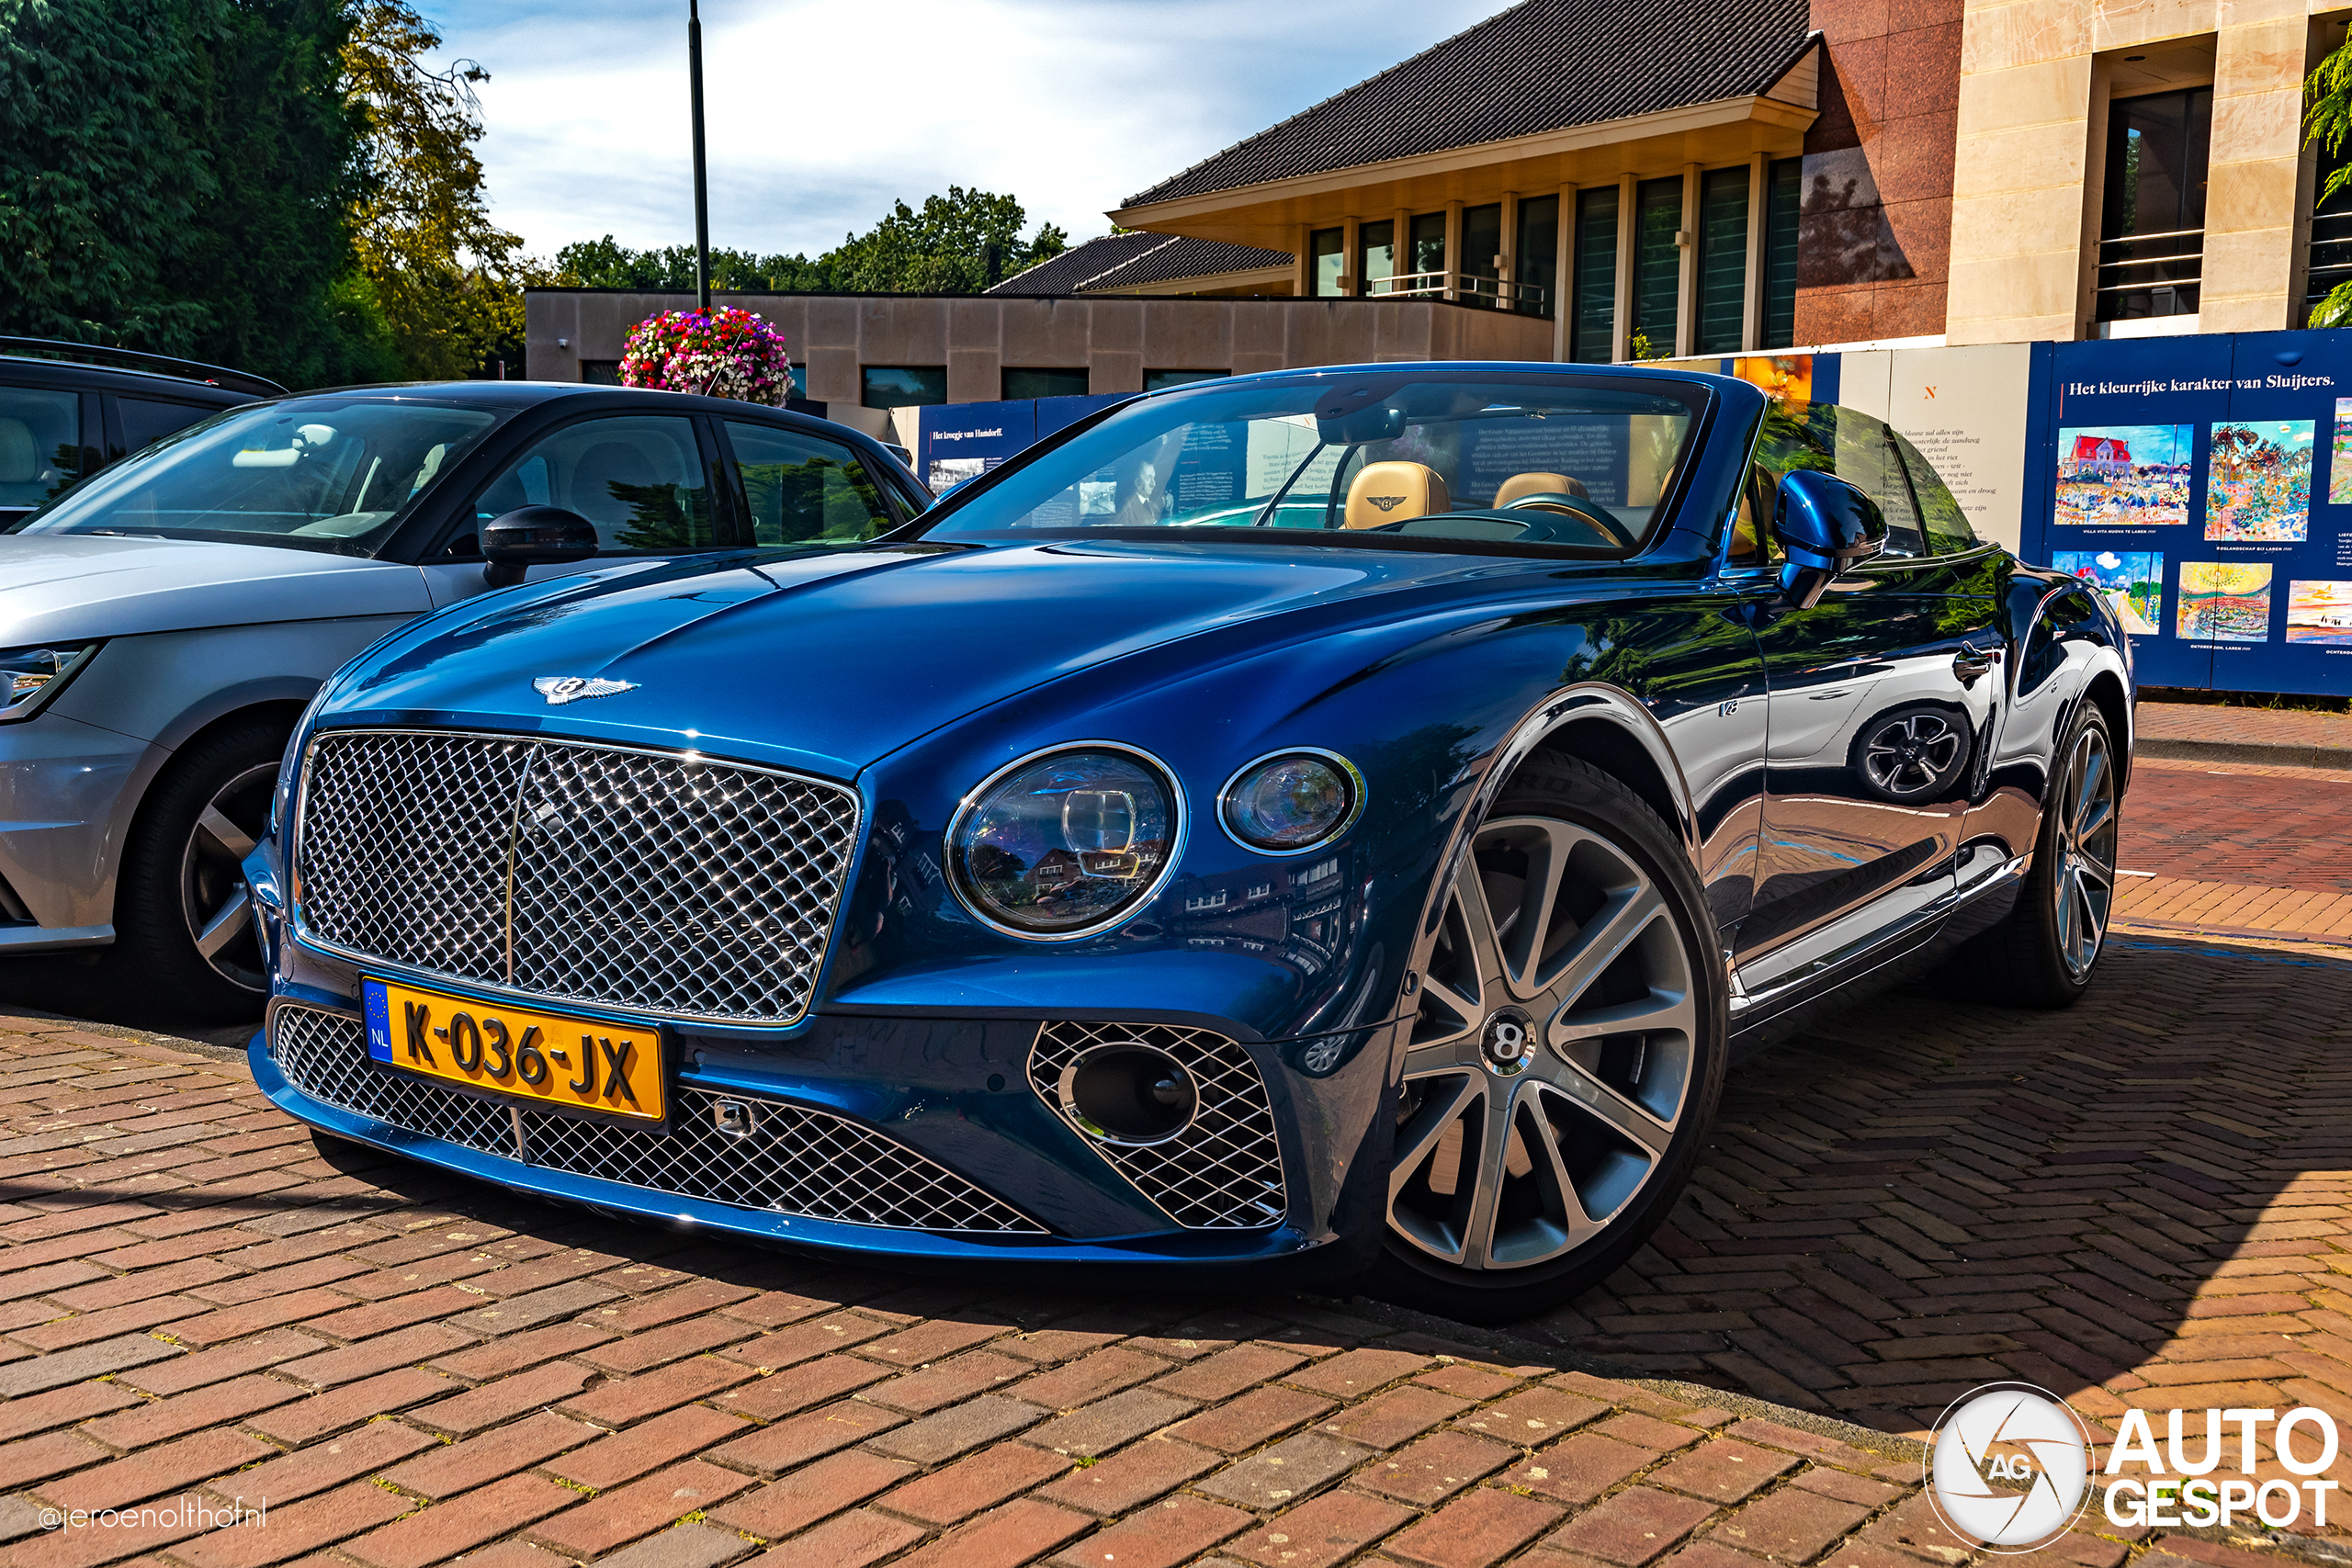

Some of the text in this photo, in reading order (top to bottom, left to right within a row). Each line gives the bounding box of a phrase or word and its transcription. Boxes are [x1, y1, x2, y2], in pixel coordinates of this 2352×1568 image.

[1924, 386, 1938, 400] N
[2069, 374, 2335, 396] Het kleurrijke karakter van Sluijters.
[933, 431, 943, 440] Het
[944, 430, 963, 441] kroegje
[975, 427, 1003, 438] Hamdorff.
[1719, 700, 1740, 717] V8
[372, 1028, 389, 1048] NL
[404, 1000, 637, 1101] K-036-JX
